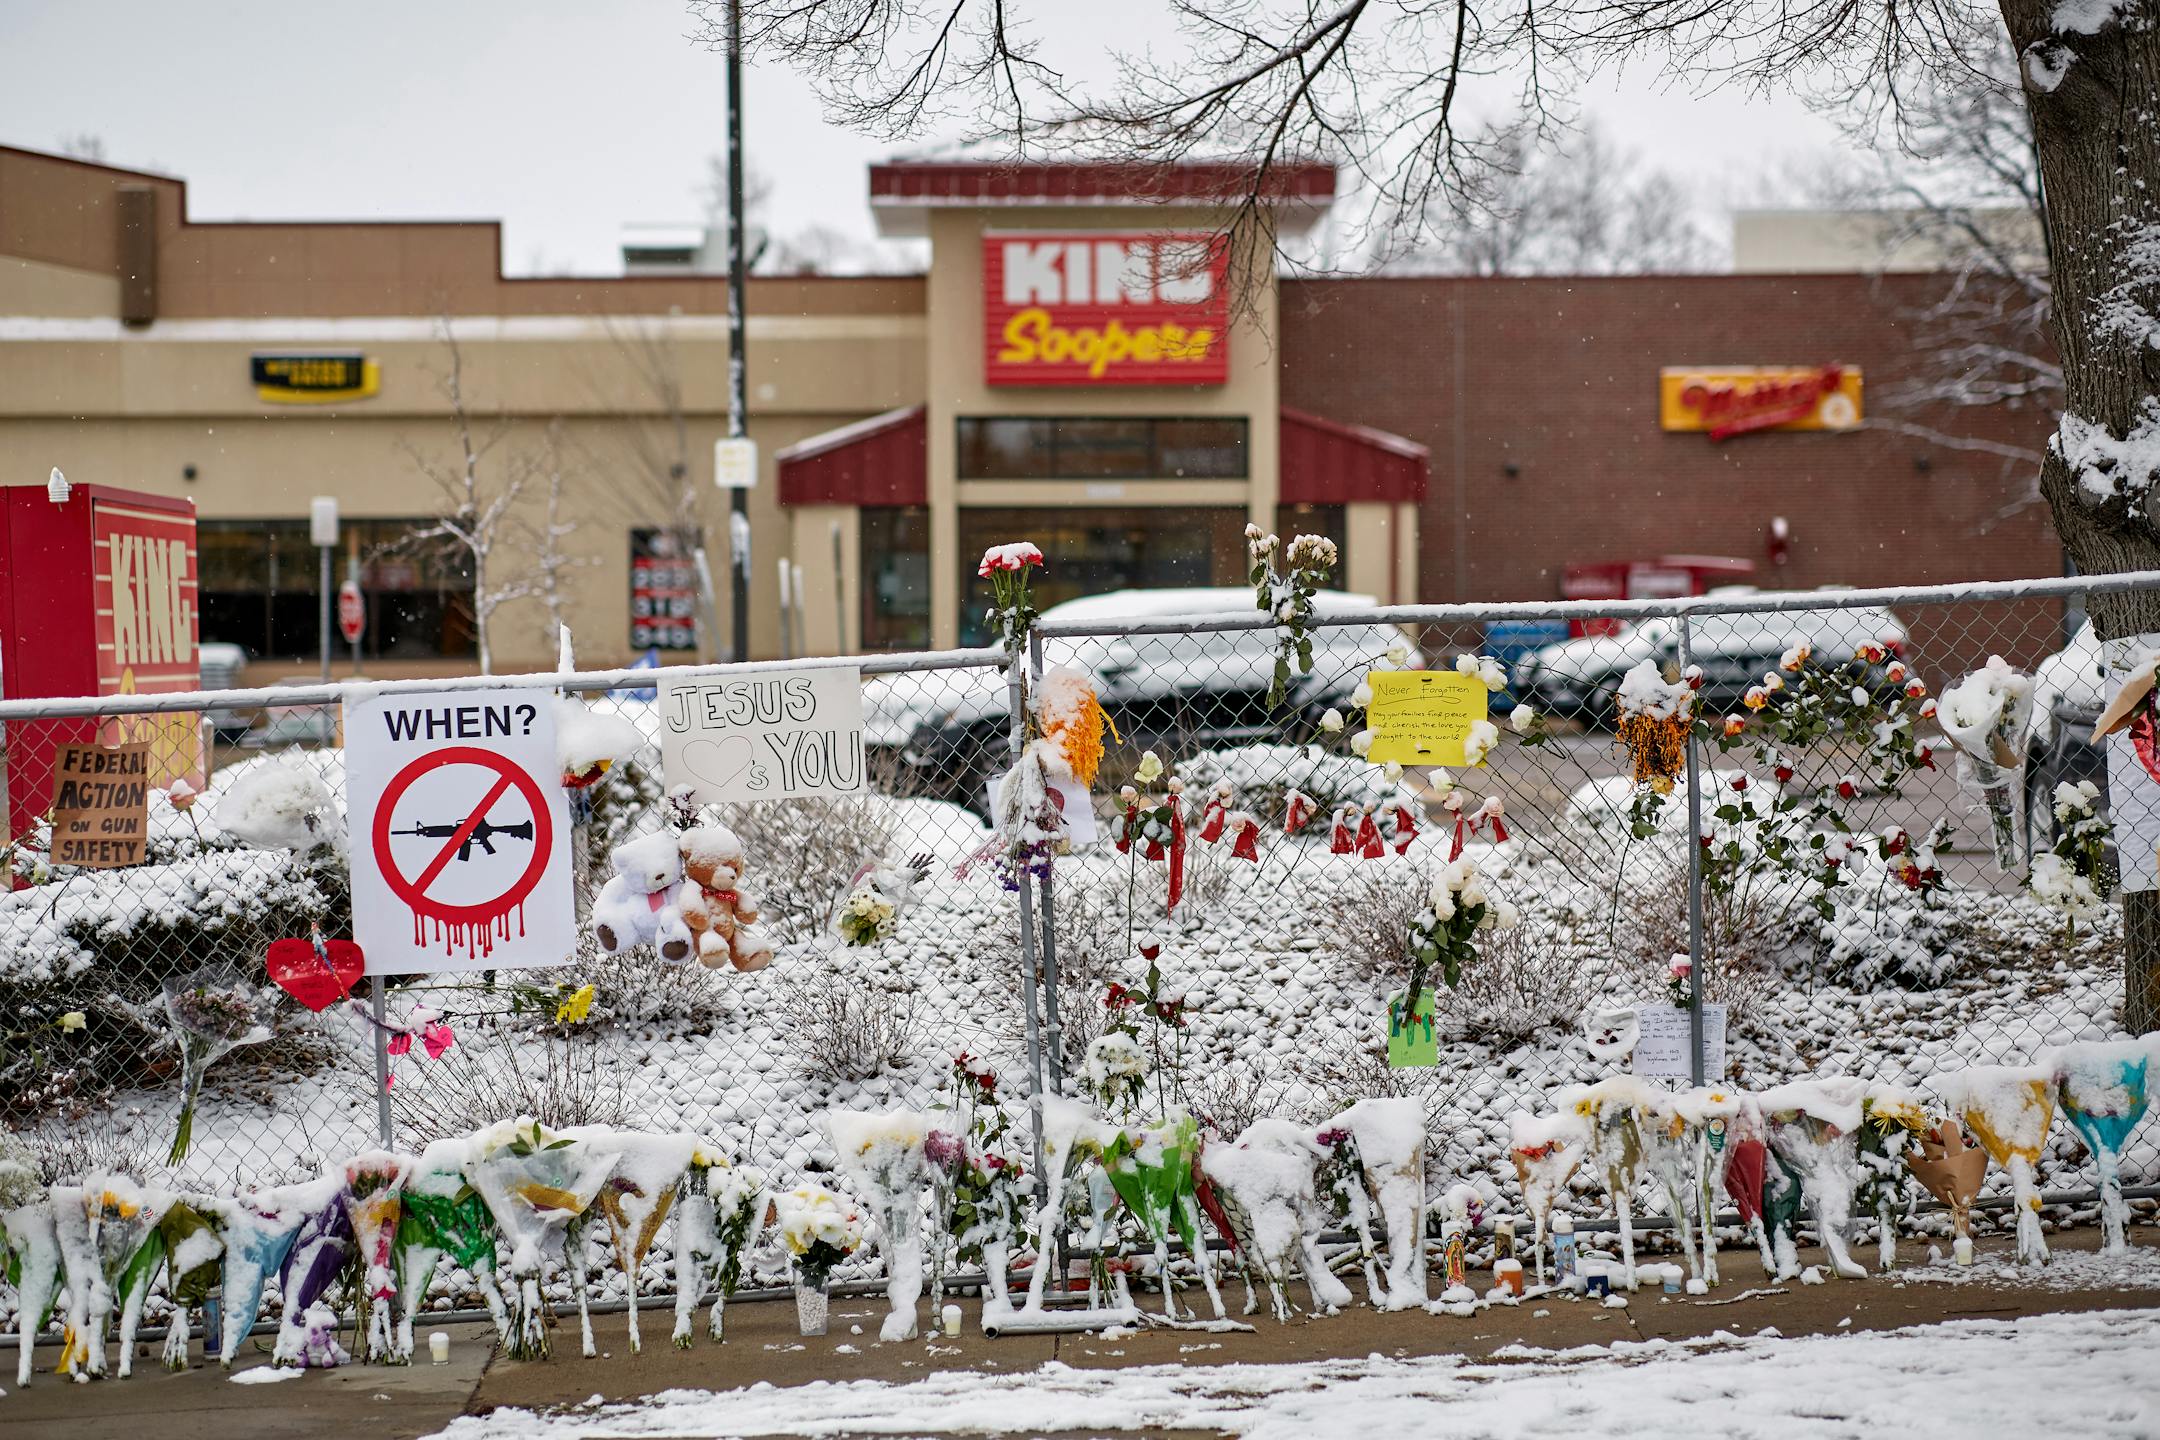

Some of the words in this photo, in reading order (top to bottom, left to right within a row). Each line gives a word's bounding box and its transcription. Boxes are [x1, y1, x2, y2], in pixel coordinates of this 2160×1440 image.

[1002, 241, 1212, 304] KING
[998, 308, 1215, 378] Soopers
[109, 533, 192, 664] KING
[1378, 683, 1411, 696] Never
[1421, 683, 1470, 697] Forgotten
[667, 677, 816, 733] JESUS
[1387, 712, 1400, 720] your
[383, 704, 537, 742] WHEN?
[1455, 723, 1469, 732] you
[63, 749, 147, 775] FEDERAL
[763, 730, 861, 791] YOU
[55, 780, 146, 809] ACTION
[70, 821, 90, 833] ON
[101, 818, 138, 834] GUN
[61, 840, 138, 862] SAFETY
